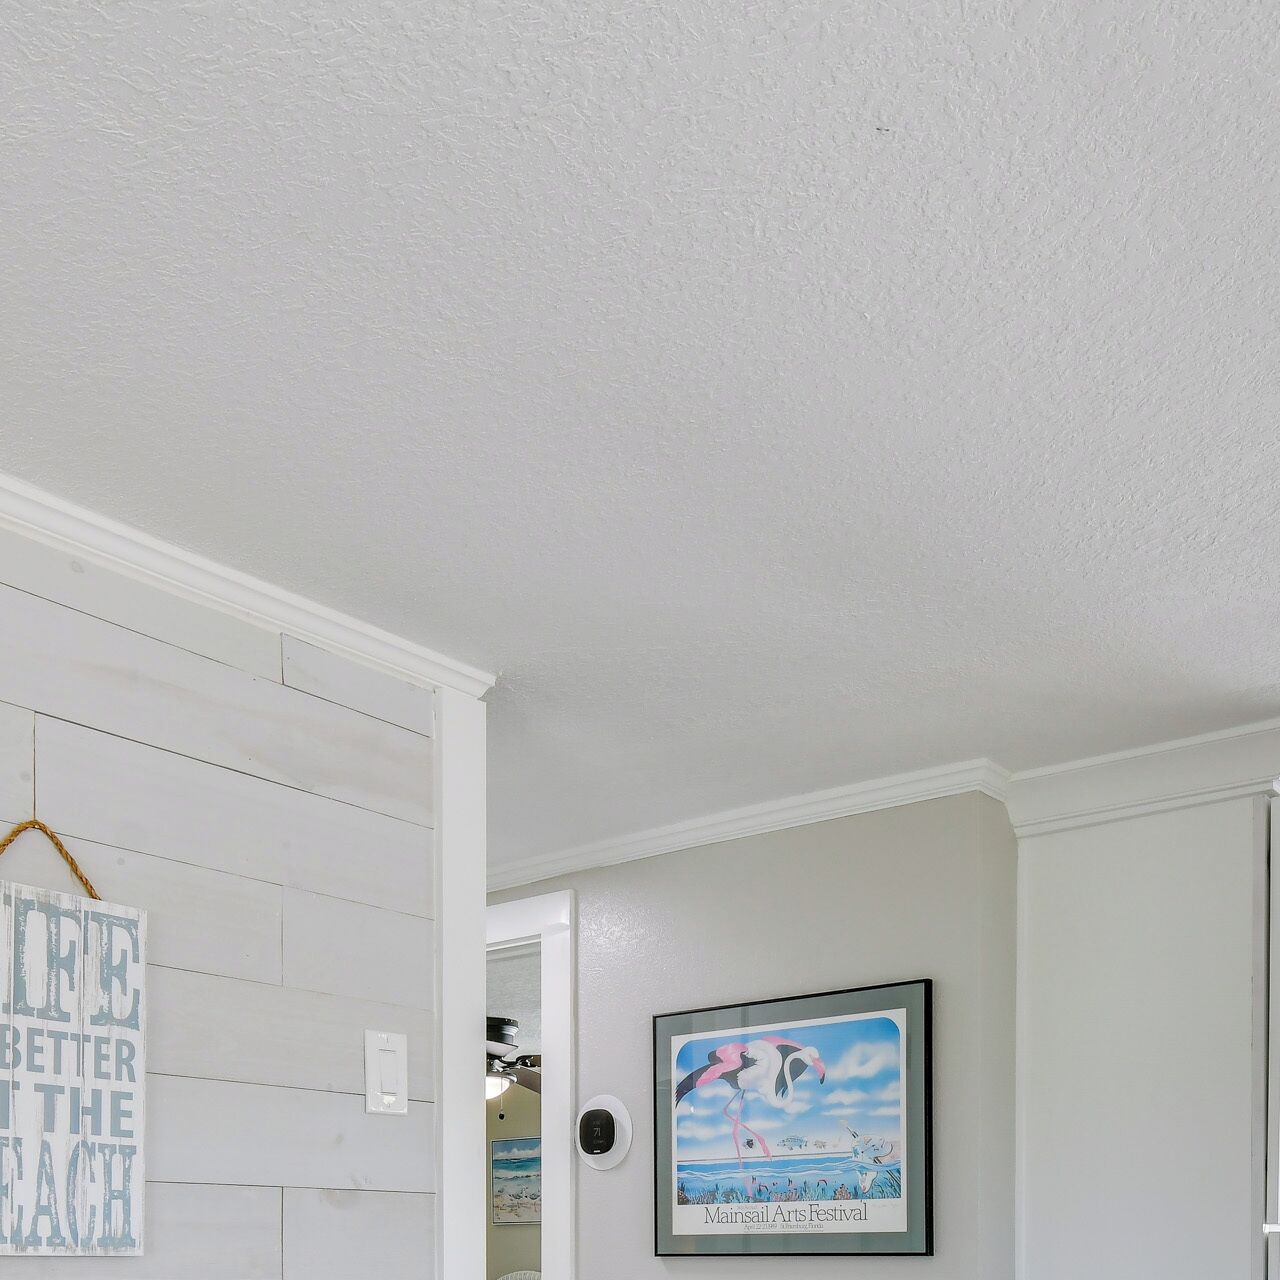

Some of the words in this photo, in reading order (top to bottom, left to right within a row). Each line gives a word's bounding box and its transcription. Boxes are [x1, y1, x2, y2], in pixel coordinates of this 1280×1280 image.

[33, 1083, 135, 1139] THE
[704, 1205, 771, 1224] Mainsail
[771, 1204, 806, 1222] Arts
[808, 1202, 868, 1222] Festival
